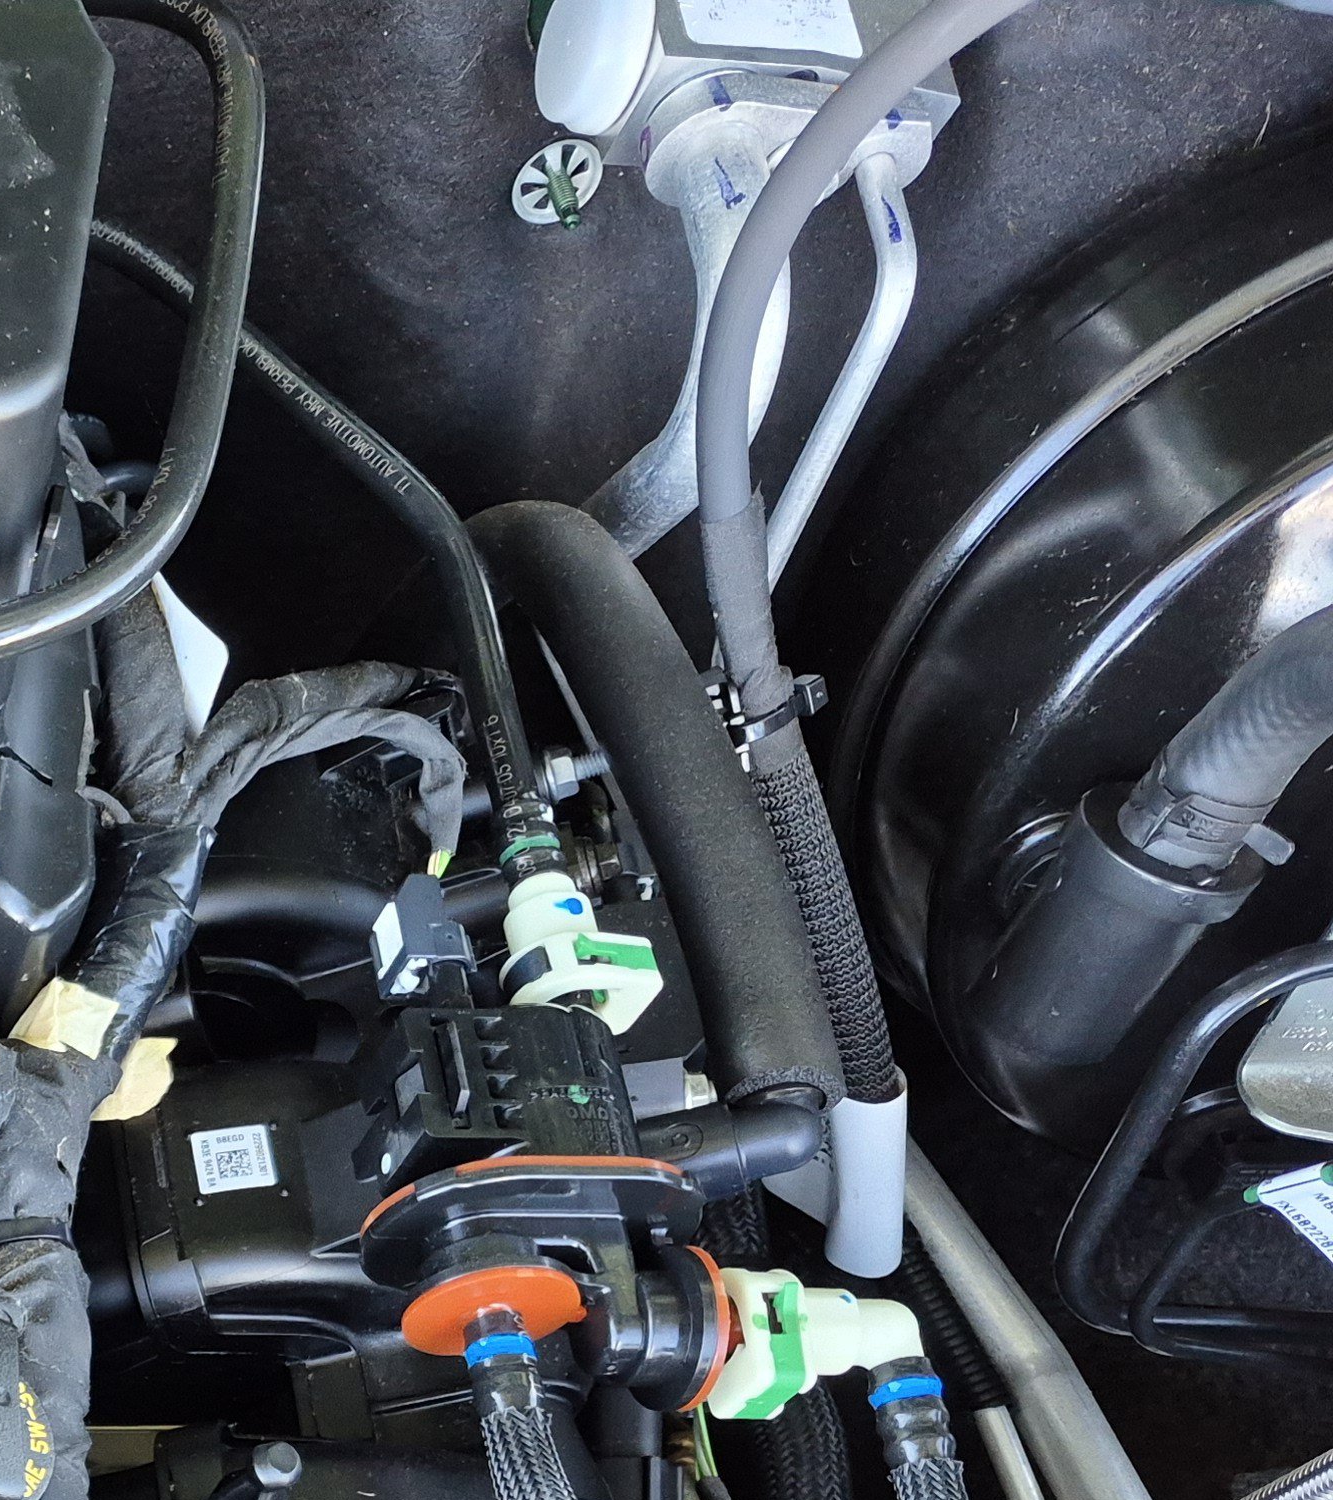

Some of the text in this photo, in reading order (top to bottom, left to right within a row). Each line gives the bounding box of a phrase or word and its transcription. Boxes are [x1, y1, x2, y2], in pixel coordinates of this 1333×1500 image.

[238, 333, 300, 395] PERMBLOK
[294, 390, 326, 418] MRY
[320, 409, 398, 478] AUTOMOTIVE
